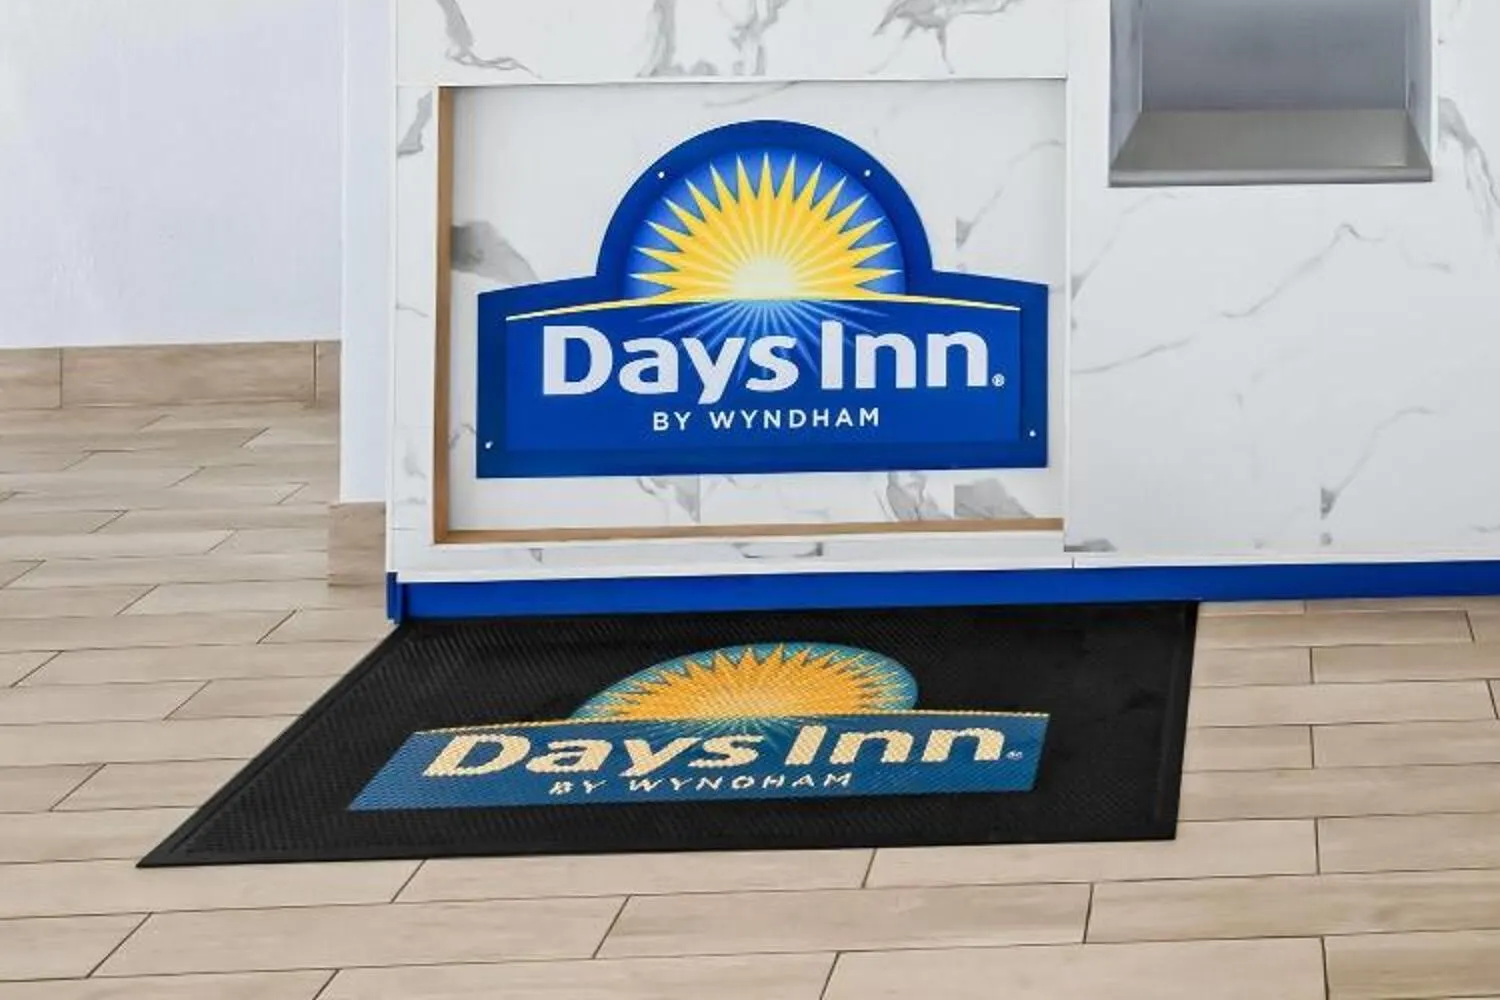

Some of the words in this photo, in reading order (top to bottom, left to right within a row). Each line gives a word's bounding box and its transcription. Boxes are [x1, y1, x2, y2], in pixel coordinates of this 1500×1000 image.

[543, 325, 799, 405] Days
[653, 411, 691, 431] BY
[709, 407, 880, 429] WYNDHAM
[421, 733, 765, 778] Days
[549, 780, 606, 795] BY
[628, 772, 853, 792] WYNDHAM
